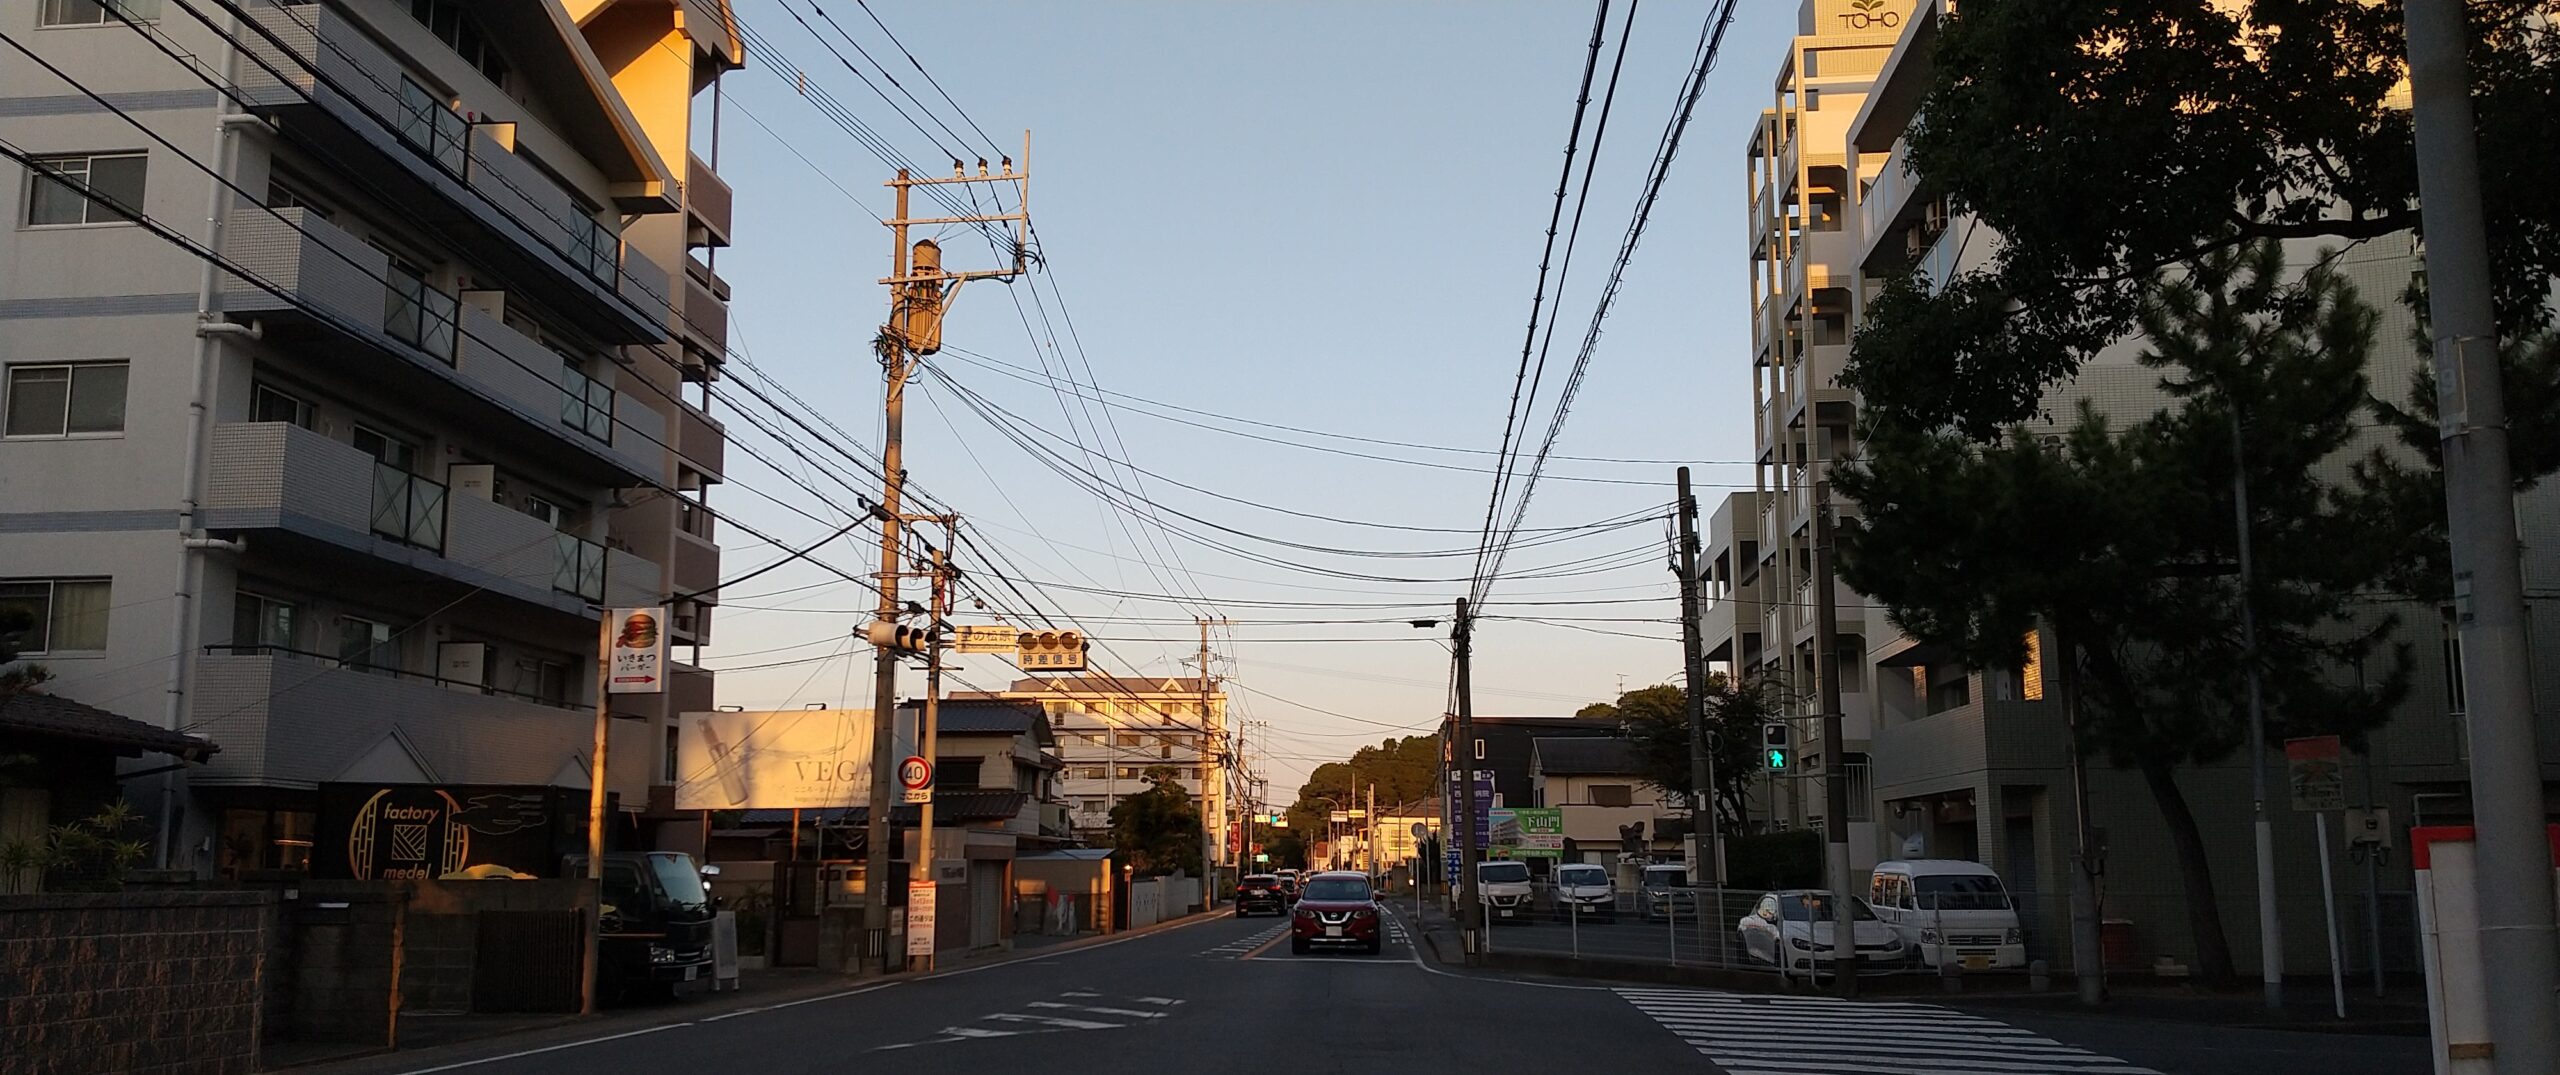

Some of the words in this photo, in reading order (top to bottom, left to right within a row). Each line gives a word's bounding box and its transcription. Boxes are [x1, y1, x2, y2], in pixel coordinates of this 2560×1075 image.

[1838, 11, 1899, 29] TOHO
[617, 653, 656, 662] いきまつ
[1023, 654, 1077, 665] 時差信号
[905, 766, 923, 780] 40
[384, 802, 440, 824] factory
[1528, 816, 1560, 828] 下山門
[383, 863, 431, 880] medel
